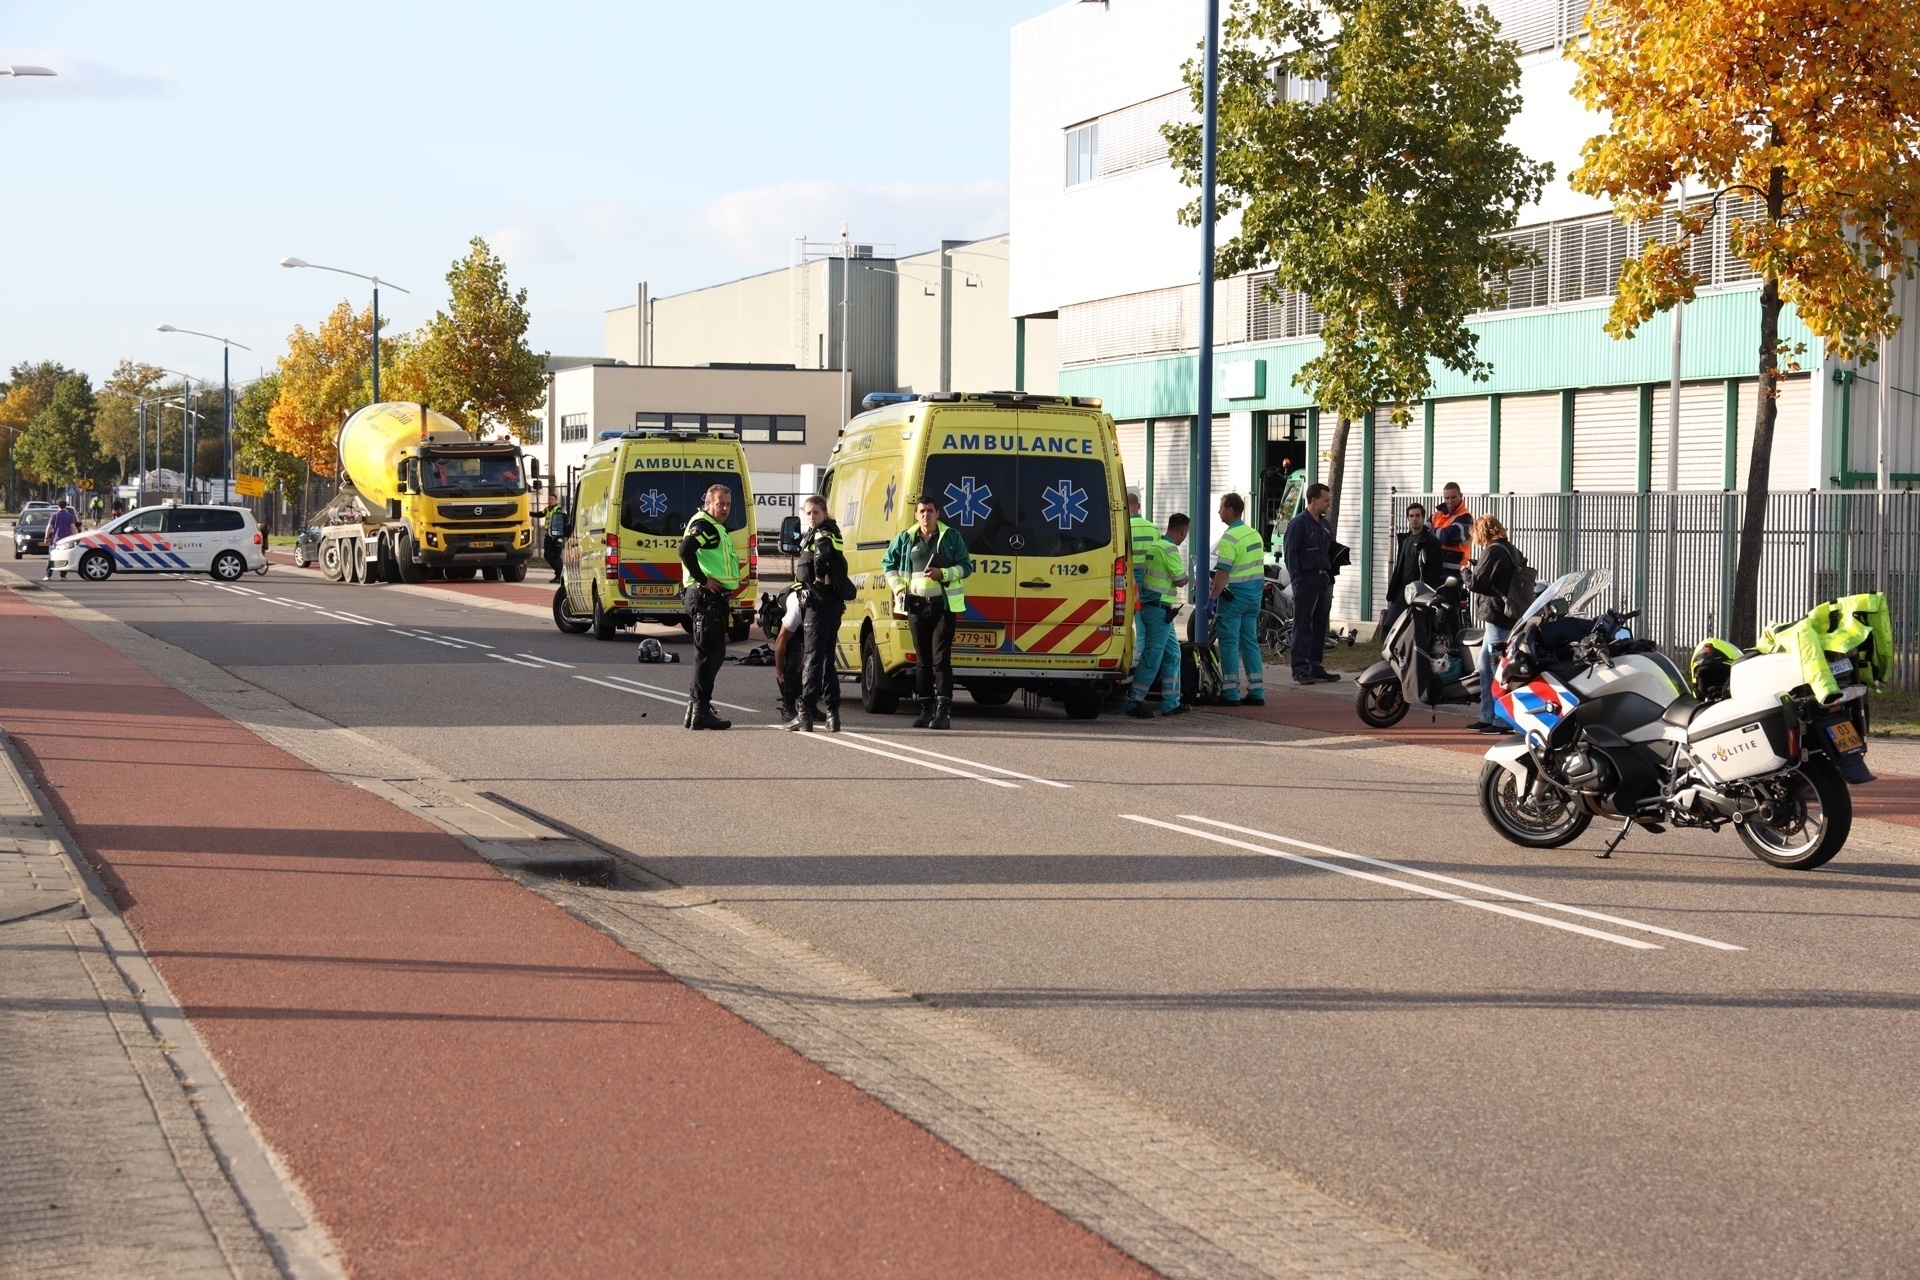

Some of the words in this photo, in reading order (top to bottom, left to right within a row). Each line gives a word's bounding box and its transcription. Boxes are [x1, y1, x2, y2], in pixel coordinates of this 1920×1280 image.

[942, 434, 1093, 454] AMBULANCE
[634, 458, 735, 470] AMBULANCE
[755, 495, 794, 506] AGEL
[970, 559, 1012, 574] 1125
[638, 585, 671, 594] JP-856-V
[1837, 725, 1850, 735] 03
[1834, 735, 1863, 750] MR-NN
[1711, 740, 1758, 762] POLITIE
